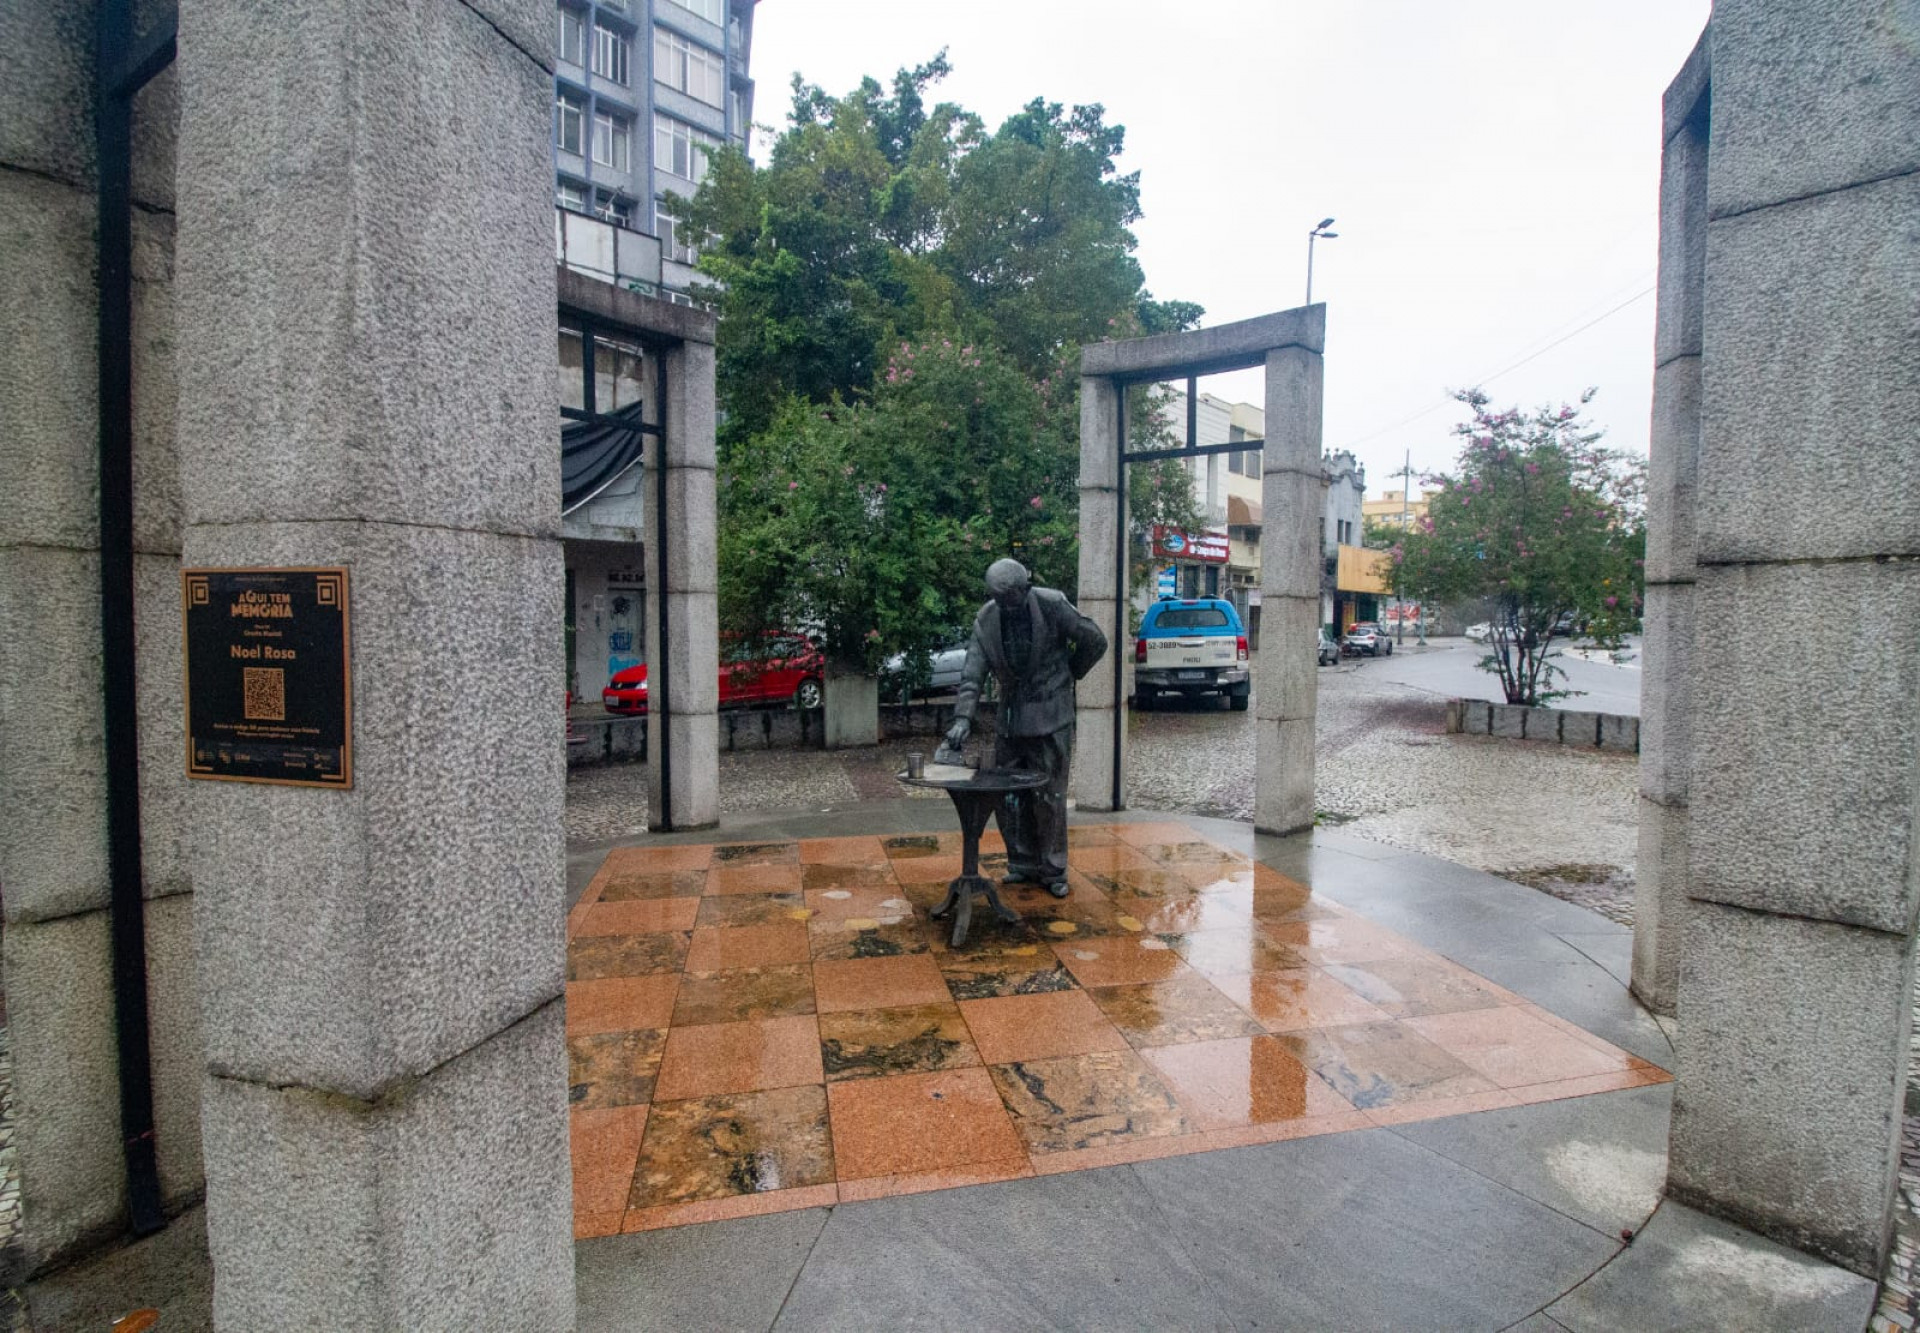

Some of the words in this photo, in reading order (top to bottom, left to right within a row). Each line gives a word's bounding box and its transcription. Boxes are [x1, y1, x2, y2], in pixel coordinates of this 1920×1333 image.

[269, 593, 291, 603] TEM
[230, 644, 261, 659] Noel
[264, 646, 296, 660] Rosa
